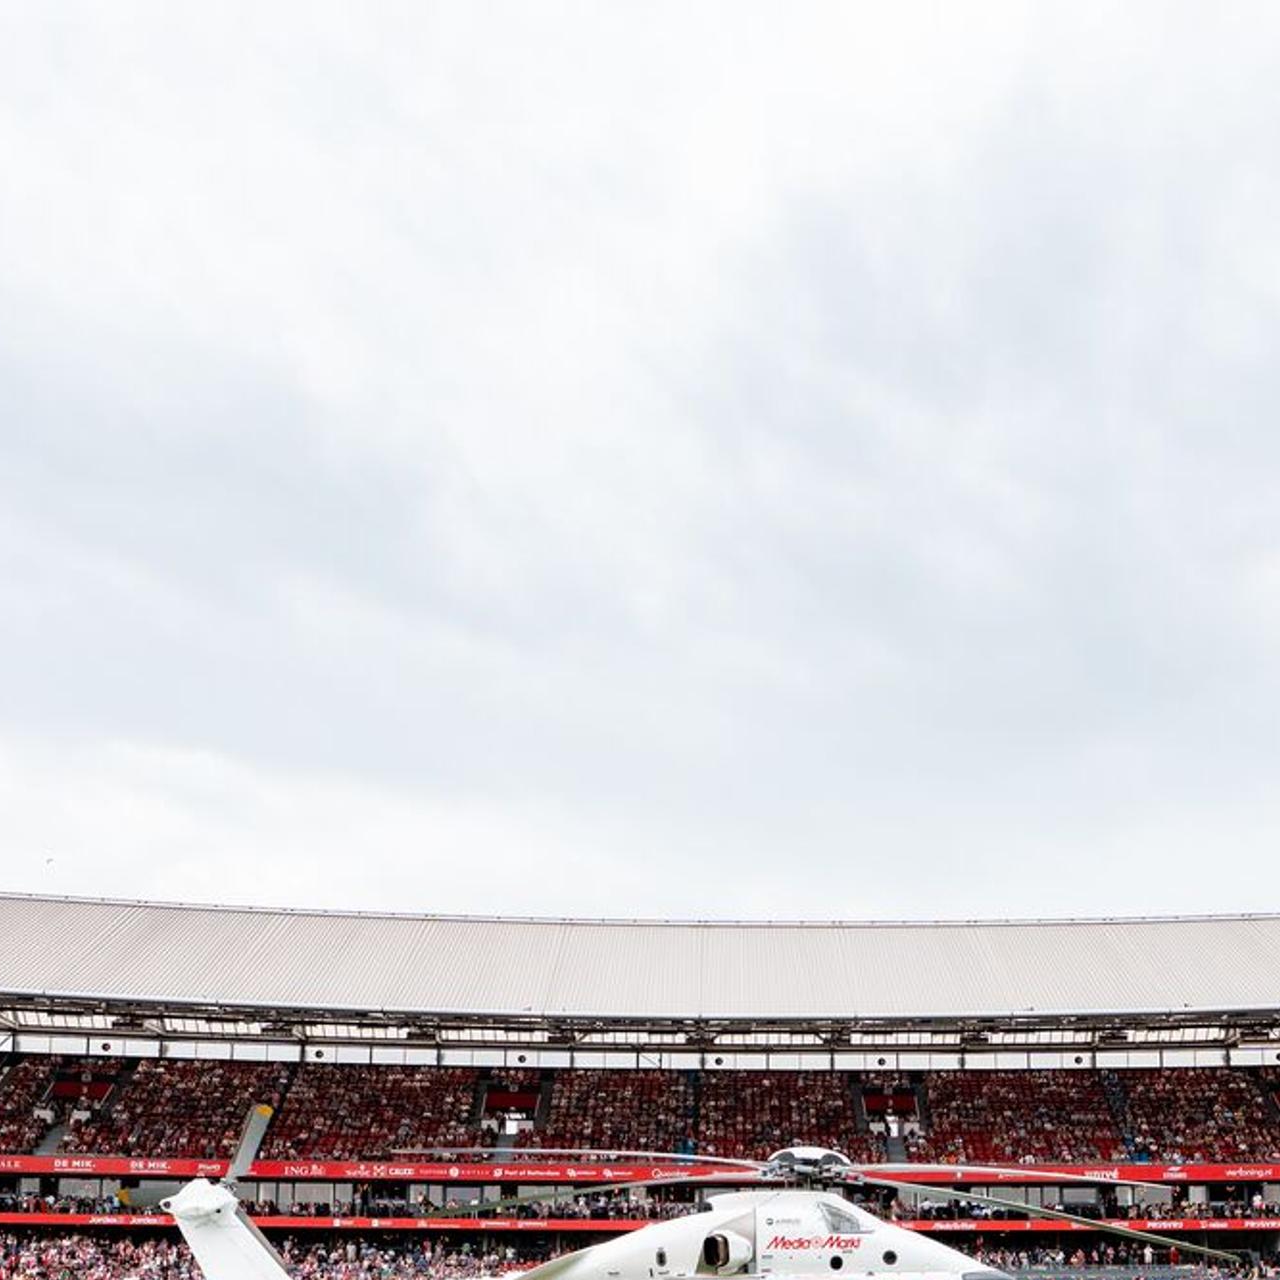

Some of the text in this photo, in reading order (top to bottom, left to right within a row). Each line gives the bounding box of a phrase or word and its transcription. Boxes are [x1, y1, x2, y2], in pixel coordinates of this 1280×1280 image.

[54, 1159, 69, 1168] DE
[130, 1160, 145, 1170] DE
[284, 1165, 308, 1177] ING
[766, 1235, 862, 1250] Media Markt
